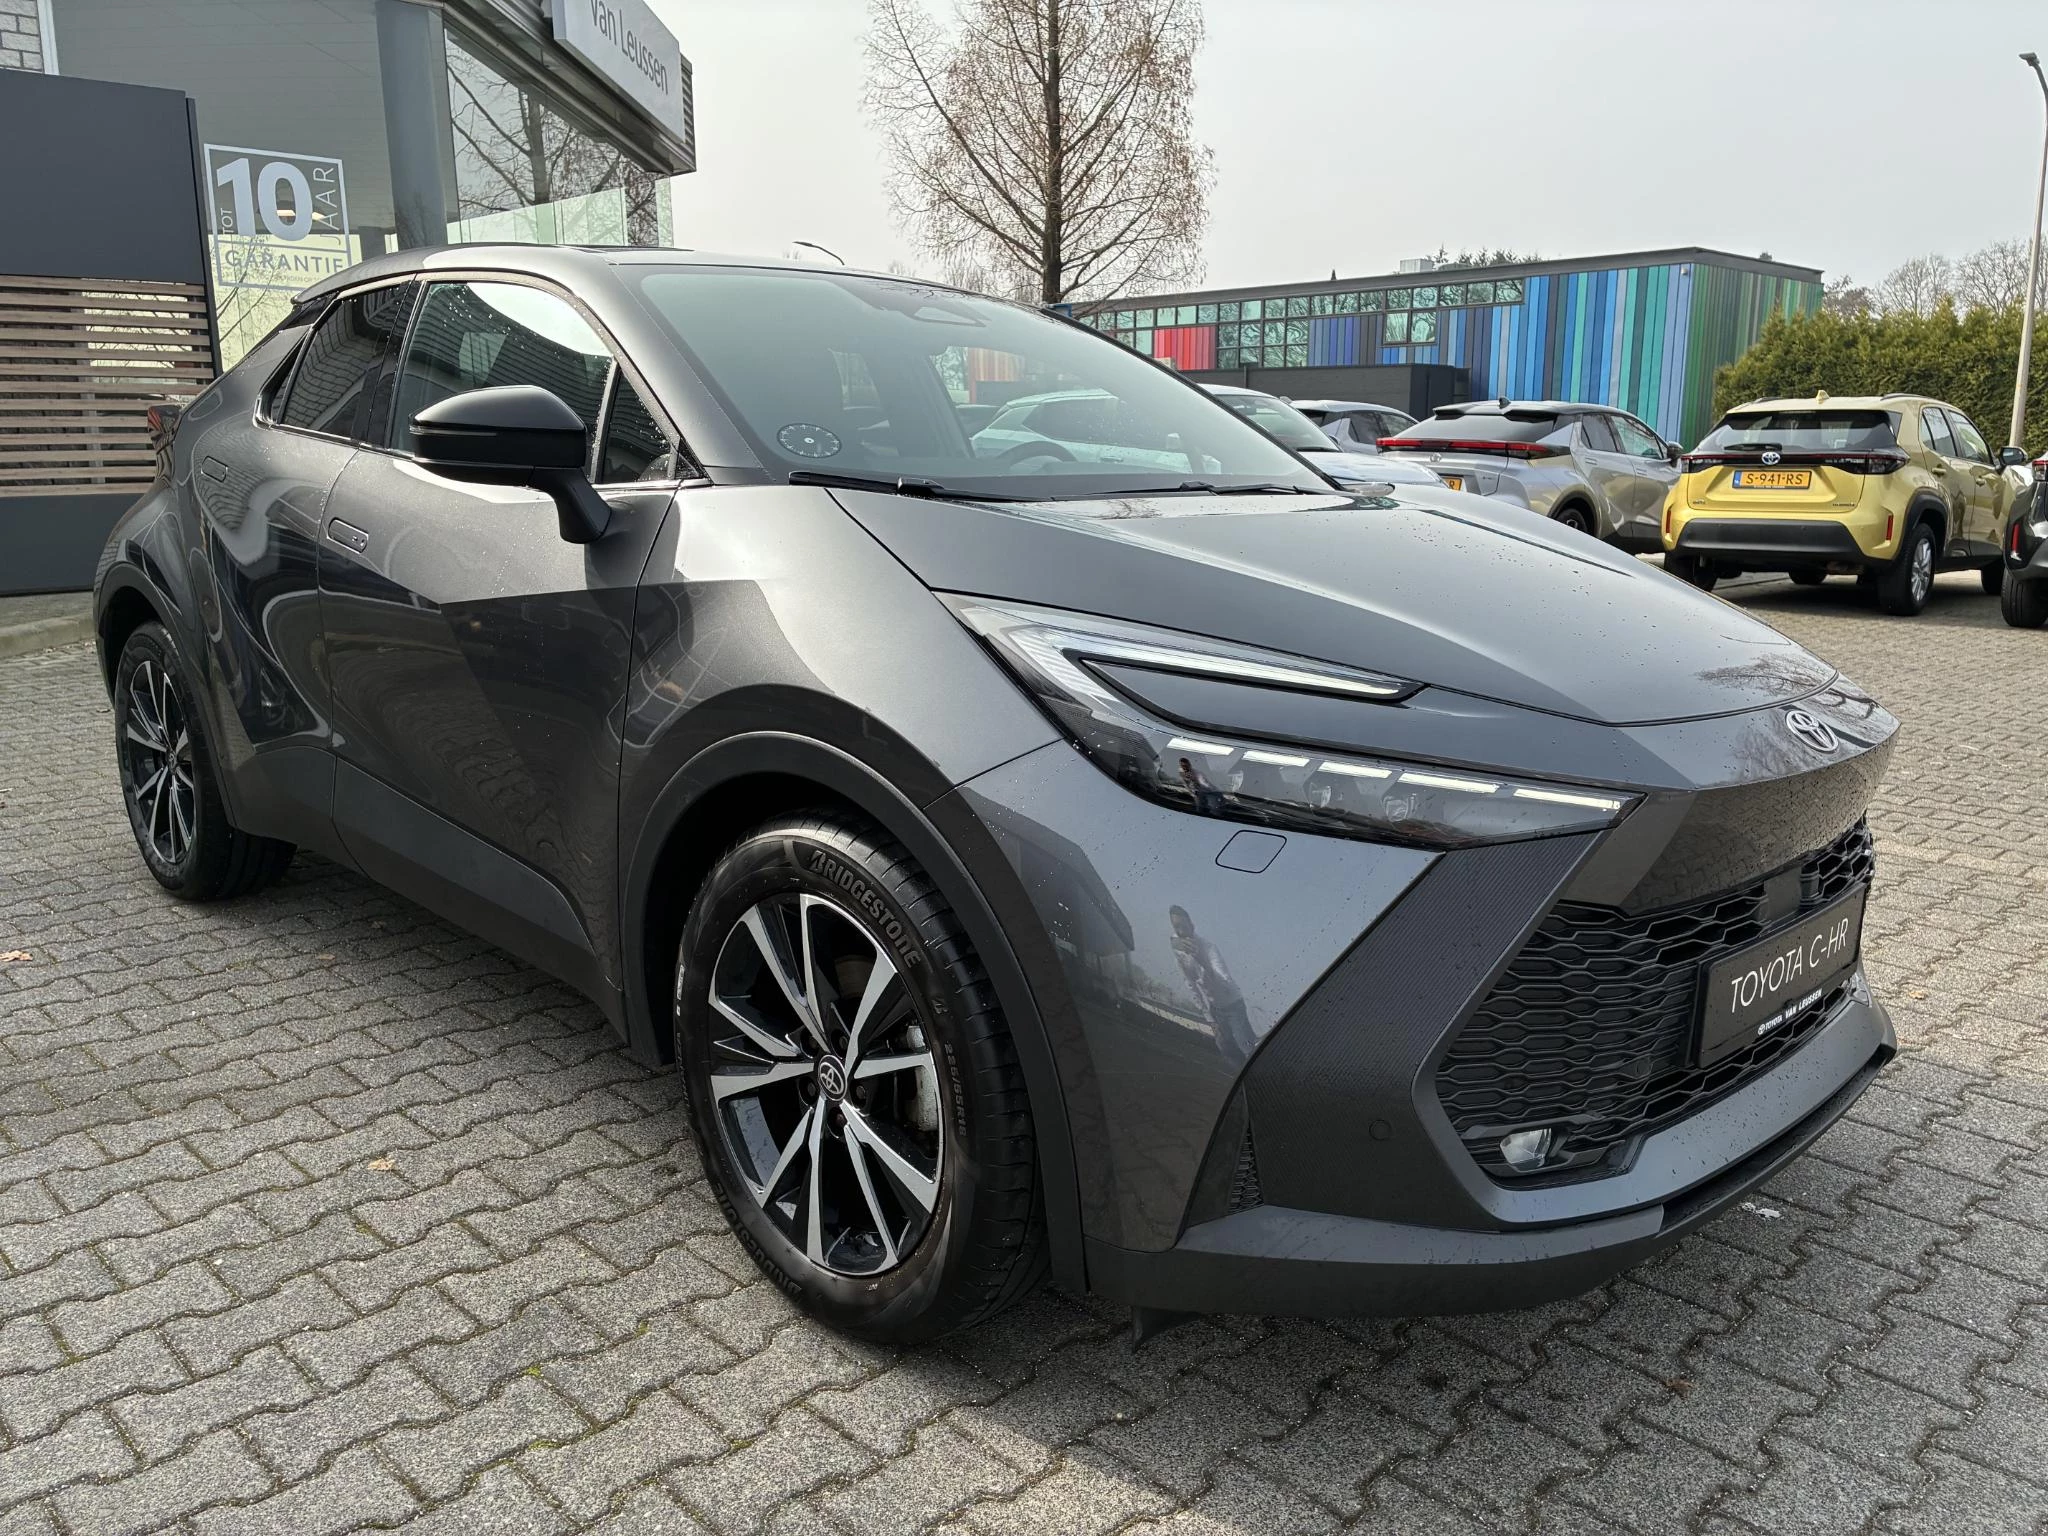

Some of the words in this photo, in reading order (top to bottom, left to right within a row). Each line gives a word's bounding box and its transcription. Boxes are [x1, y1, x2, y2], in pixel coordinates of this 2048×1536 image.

[619, 8, 668, 95] Leussen
[216, 158, 313, 241] 10
[220, 207, 235, 236] TOT
[313, 166, 342, 246] JAAR
[224, 249, 343, 273] GARANTIE
[1745, 470, 1804, 486] S-941-RS
[808, 850, 921, 969] BRIDGESTONE
[1731, 945, 1803, 1013] TOYOTA
[1809, 917, 1849, 968] C-HR
[1764, 1014, 1783, 1031] TOYOTA
[1785, 1005, 1797, 1019] VAN
[1799, 988, 1823, 1010] LEUSSEN
[943, 1041, 967, 1137] 225/55R18
